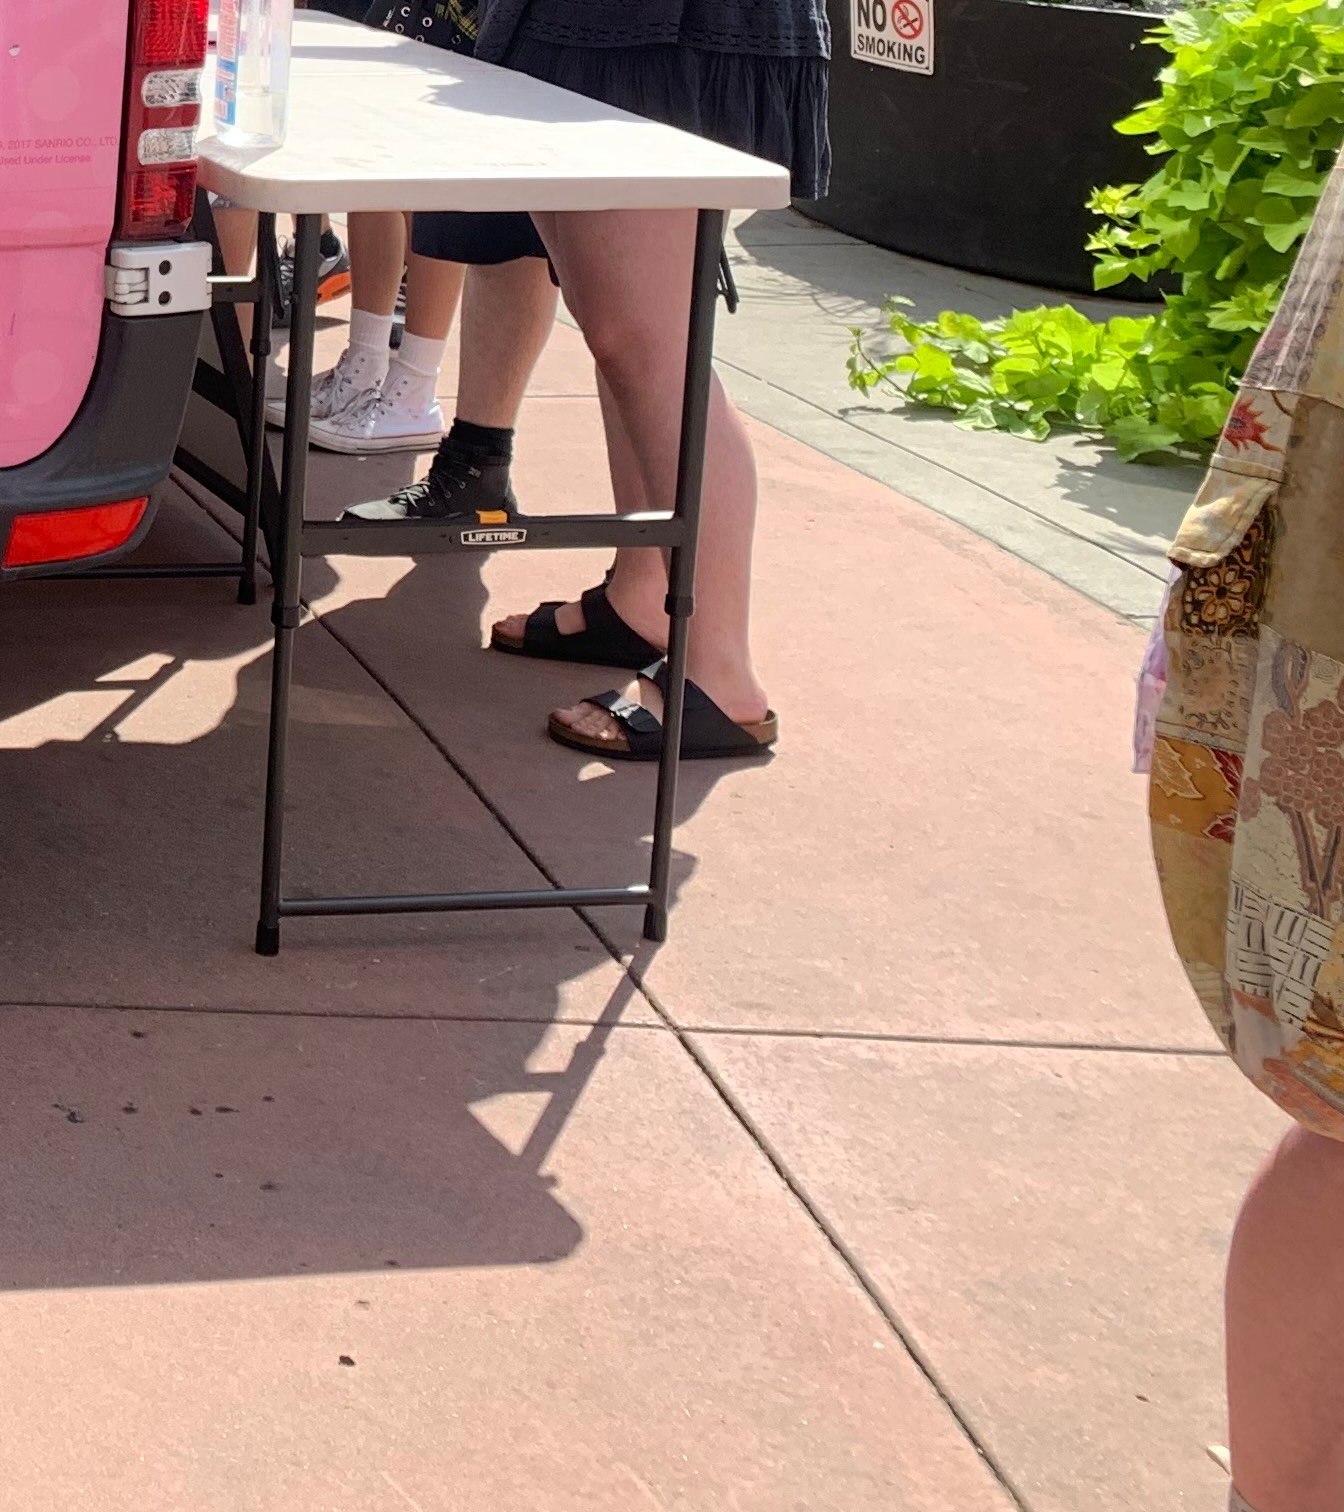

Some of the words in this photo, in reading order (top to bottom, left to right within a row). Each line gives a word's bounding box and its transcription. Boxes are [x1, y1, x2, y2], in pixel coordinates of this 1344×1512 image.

[857, 33, 925, 65] SMOKING
[35, 138, 73, 149] SANRIO
[23, 154, 53, 165] Under
[468, 531, 519, 542] LIFETIME
